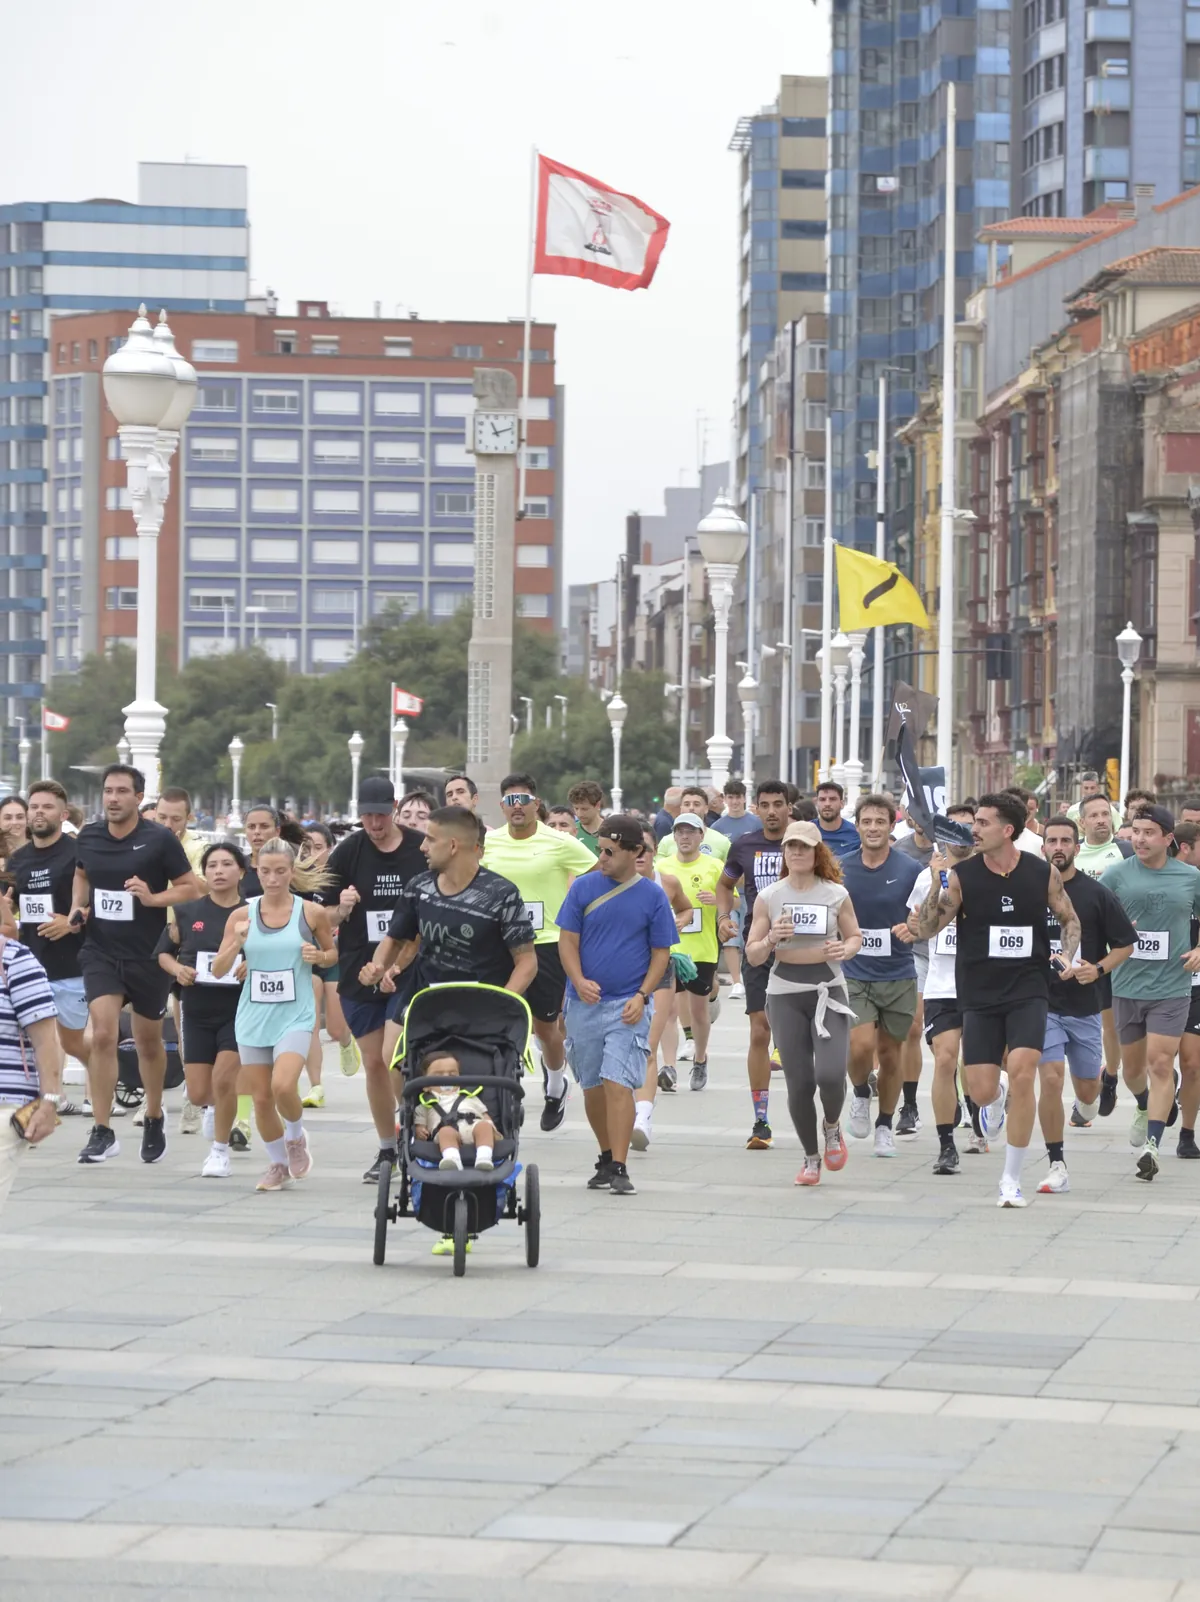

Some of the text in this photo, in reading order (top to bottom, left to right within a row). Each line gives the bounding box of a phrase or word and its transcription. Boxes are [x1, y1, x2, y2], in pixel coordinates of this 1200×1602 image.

[376, 874, 401, 883] VUELTA
[26, 902, 45, 914] 056
[101, 898, 123, 912] 072
[793, 912, 817, 925] 052
[861, 937, 883, 948] 030
[999, 935, 1024, 948] 069
[1137, 940, 1160, 951] 028
[259, 980, 285, 993] 034
